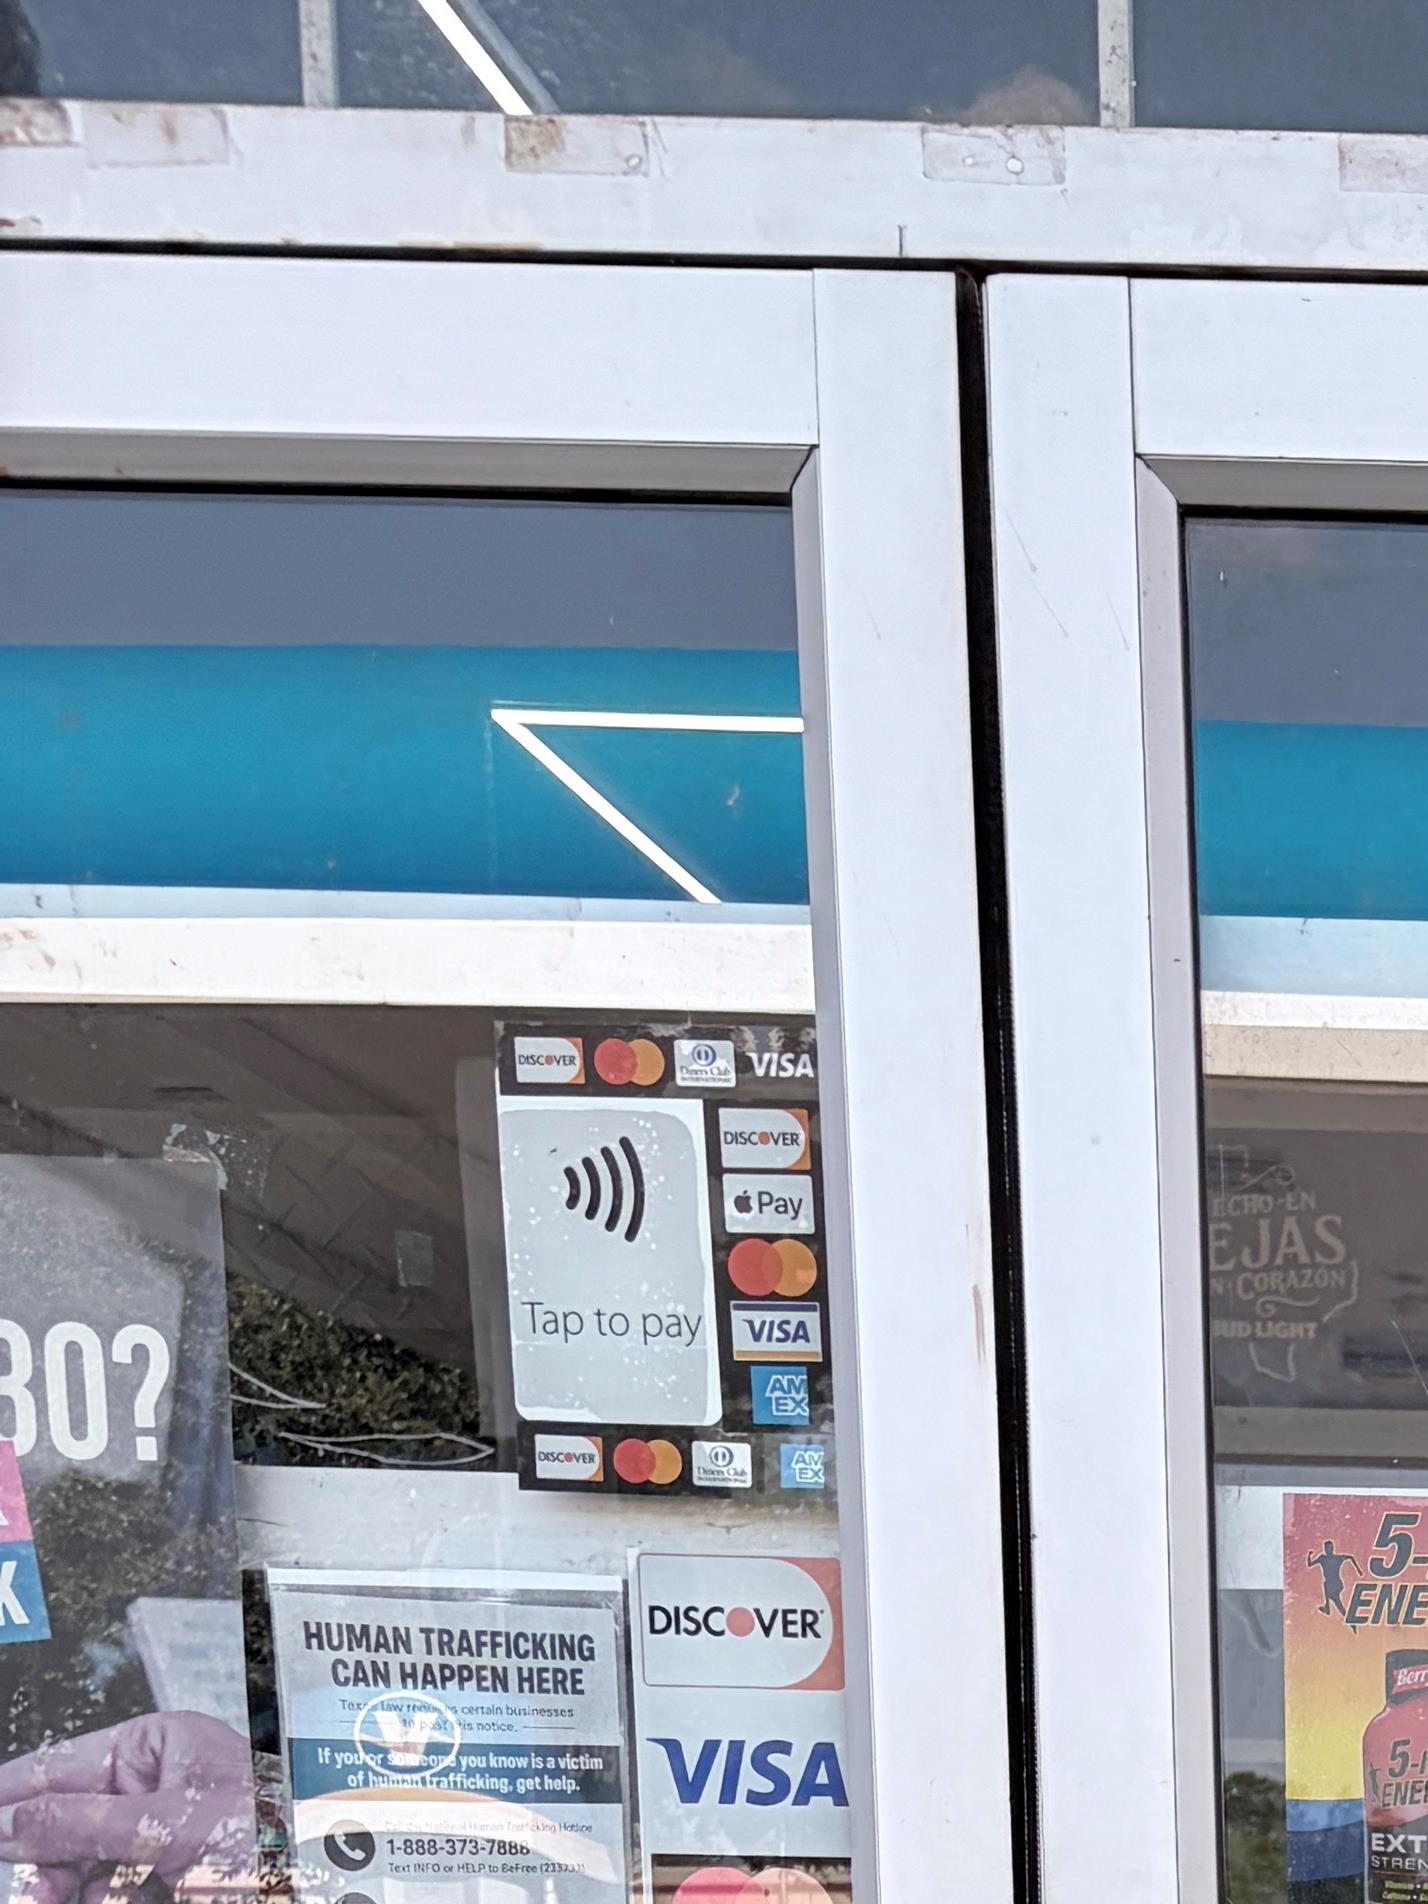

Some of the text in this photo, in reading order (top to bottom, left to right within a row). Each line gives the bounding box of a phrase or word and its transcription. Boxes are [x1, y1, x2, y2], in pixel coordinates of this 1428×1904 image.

[746, 1051, 815, 1078] VISA
[724, 1130, 802, 1147] DISCOVER
[757, 1190, 804, 1221] Pay
[521, 1301, 702, 1347] Tap to pay
[742, 1318, 811, 1344] VISA
[647, 1604, 825, 1641] DISCOVER
[303, 1620, 597, 1662] HUMAN TRAFFICKING
[331, 1658, 586, 1696] CAN HAPPEN HERE
[506, 1704, 574, 1718] businesses
[318, 1748, 332, 1764] If
[334, 1750, 364, 1769] you
[459, 1755, 487, 1772] you
[489, 1754, 529, 1769] know
[531, 1754, 544, 1769] is
[546, 1757, 556, 1769] a
[558, 1754, 604, 1771] victim
[645, 1737, 850, 1808] VISA
[347, 1771, 366, 1786] of
[425, 1773, 513, 1793] trafficking,
[516, 1776, 541, 1793] get
[544, 1775, 581, 1794] help.
[389, 1862, 411, 1874] Text
[457, 1863, 486, 1874] HELP
